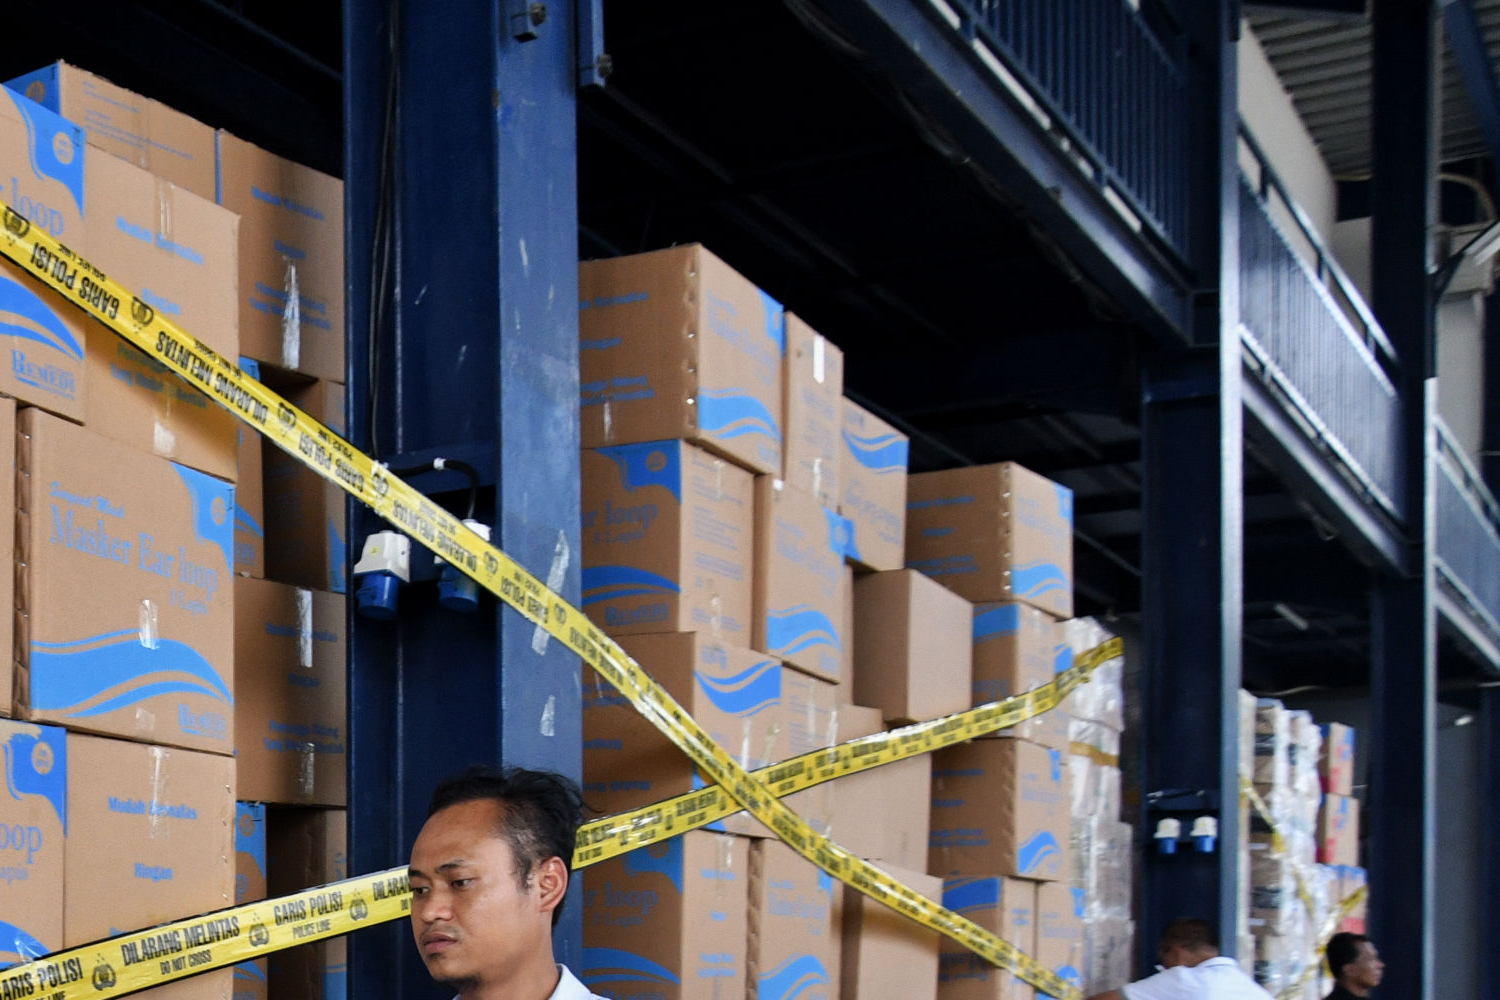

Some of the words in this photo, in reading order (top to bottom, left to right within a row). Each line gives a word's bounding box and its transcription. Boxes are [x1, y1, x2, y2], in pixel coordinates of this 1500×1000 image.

[11, 176, 65, 237] loop
[30, 241, 78, 290] POLISI
[80, 275, 121, 320] GARIS
[155, 330, 213, 387] MELINTAS
[214, 372, 268, 424] DILARANG
[50, 503, 133, 565] Masker
[138, 531, 175, 578] Ear
[179, 546, 220, 602] loop
[274, 901, 307, 927] GARIS
[309, 890, 344, 917] POLISI
[373, 875, 412, 901] DILARAN
[121, 930, 182, 967] DILARANG
[184, 915, 241, 950] MELINTAS
[172, 954, 187, 972] NOT
[37, 956, 84, 991] POLISI
